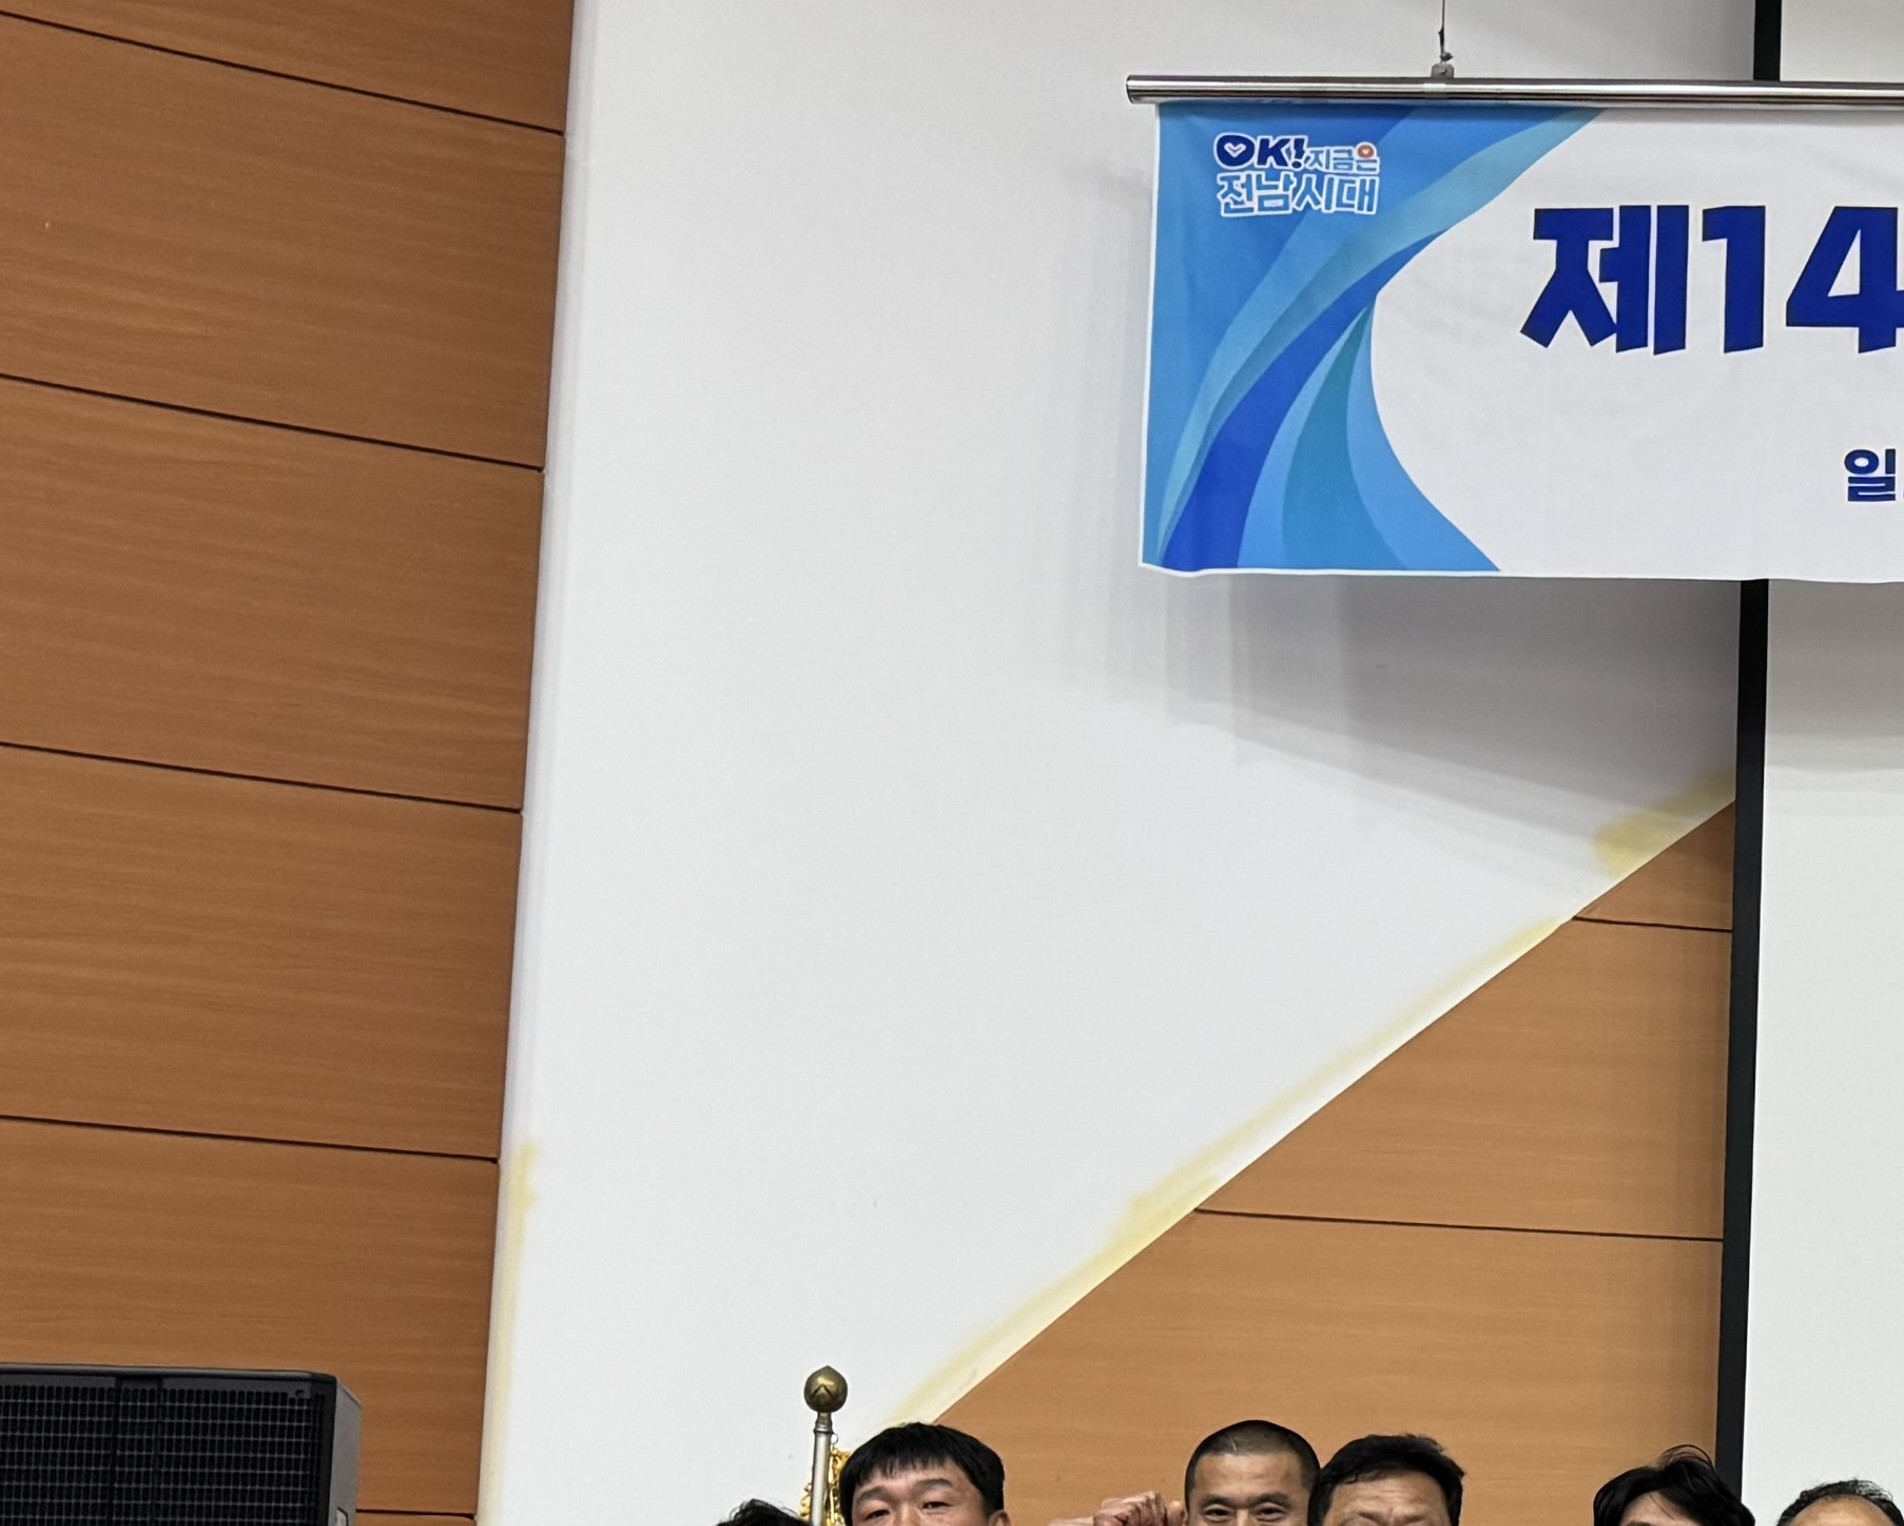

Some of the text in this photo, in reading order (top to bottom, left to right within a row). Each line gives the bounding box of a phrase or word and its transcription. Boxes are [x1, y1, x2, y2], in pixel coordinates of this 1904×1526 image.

[1213, 132, 1380, 174] OK! 지금은
[1217, 171, 1380, 217] 전남시대
